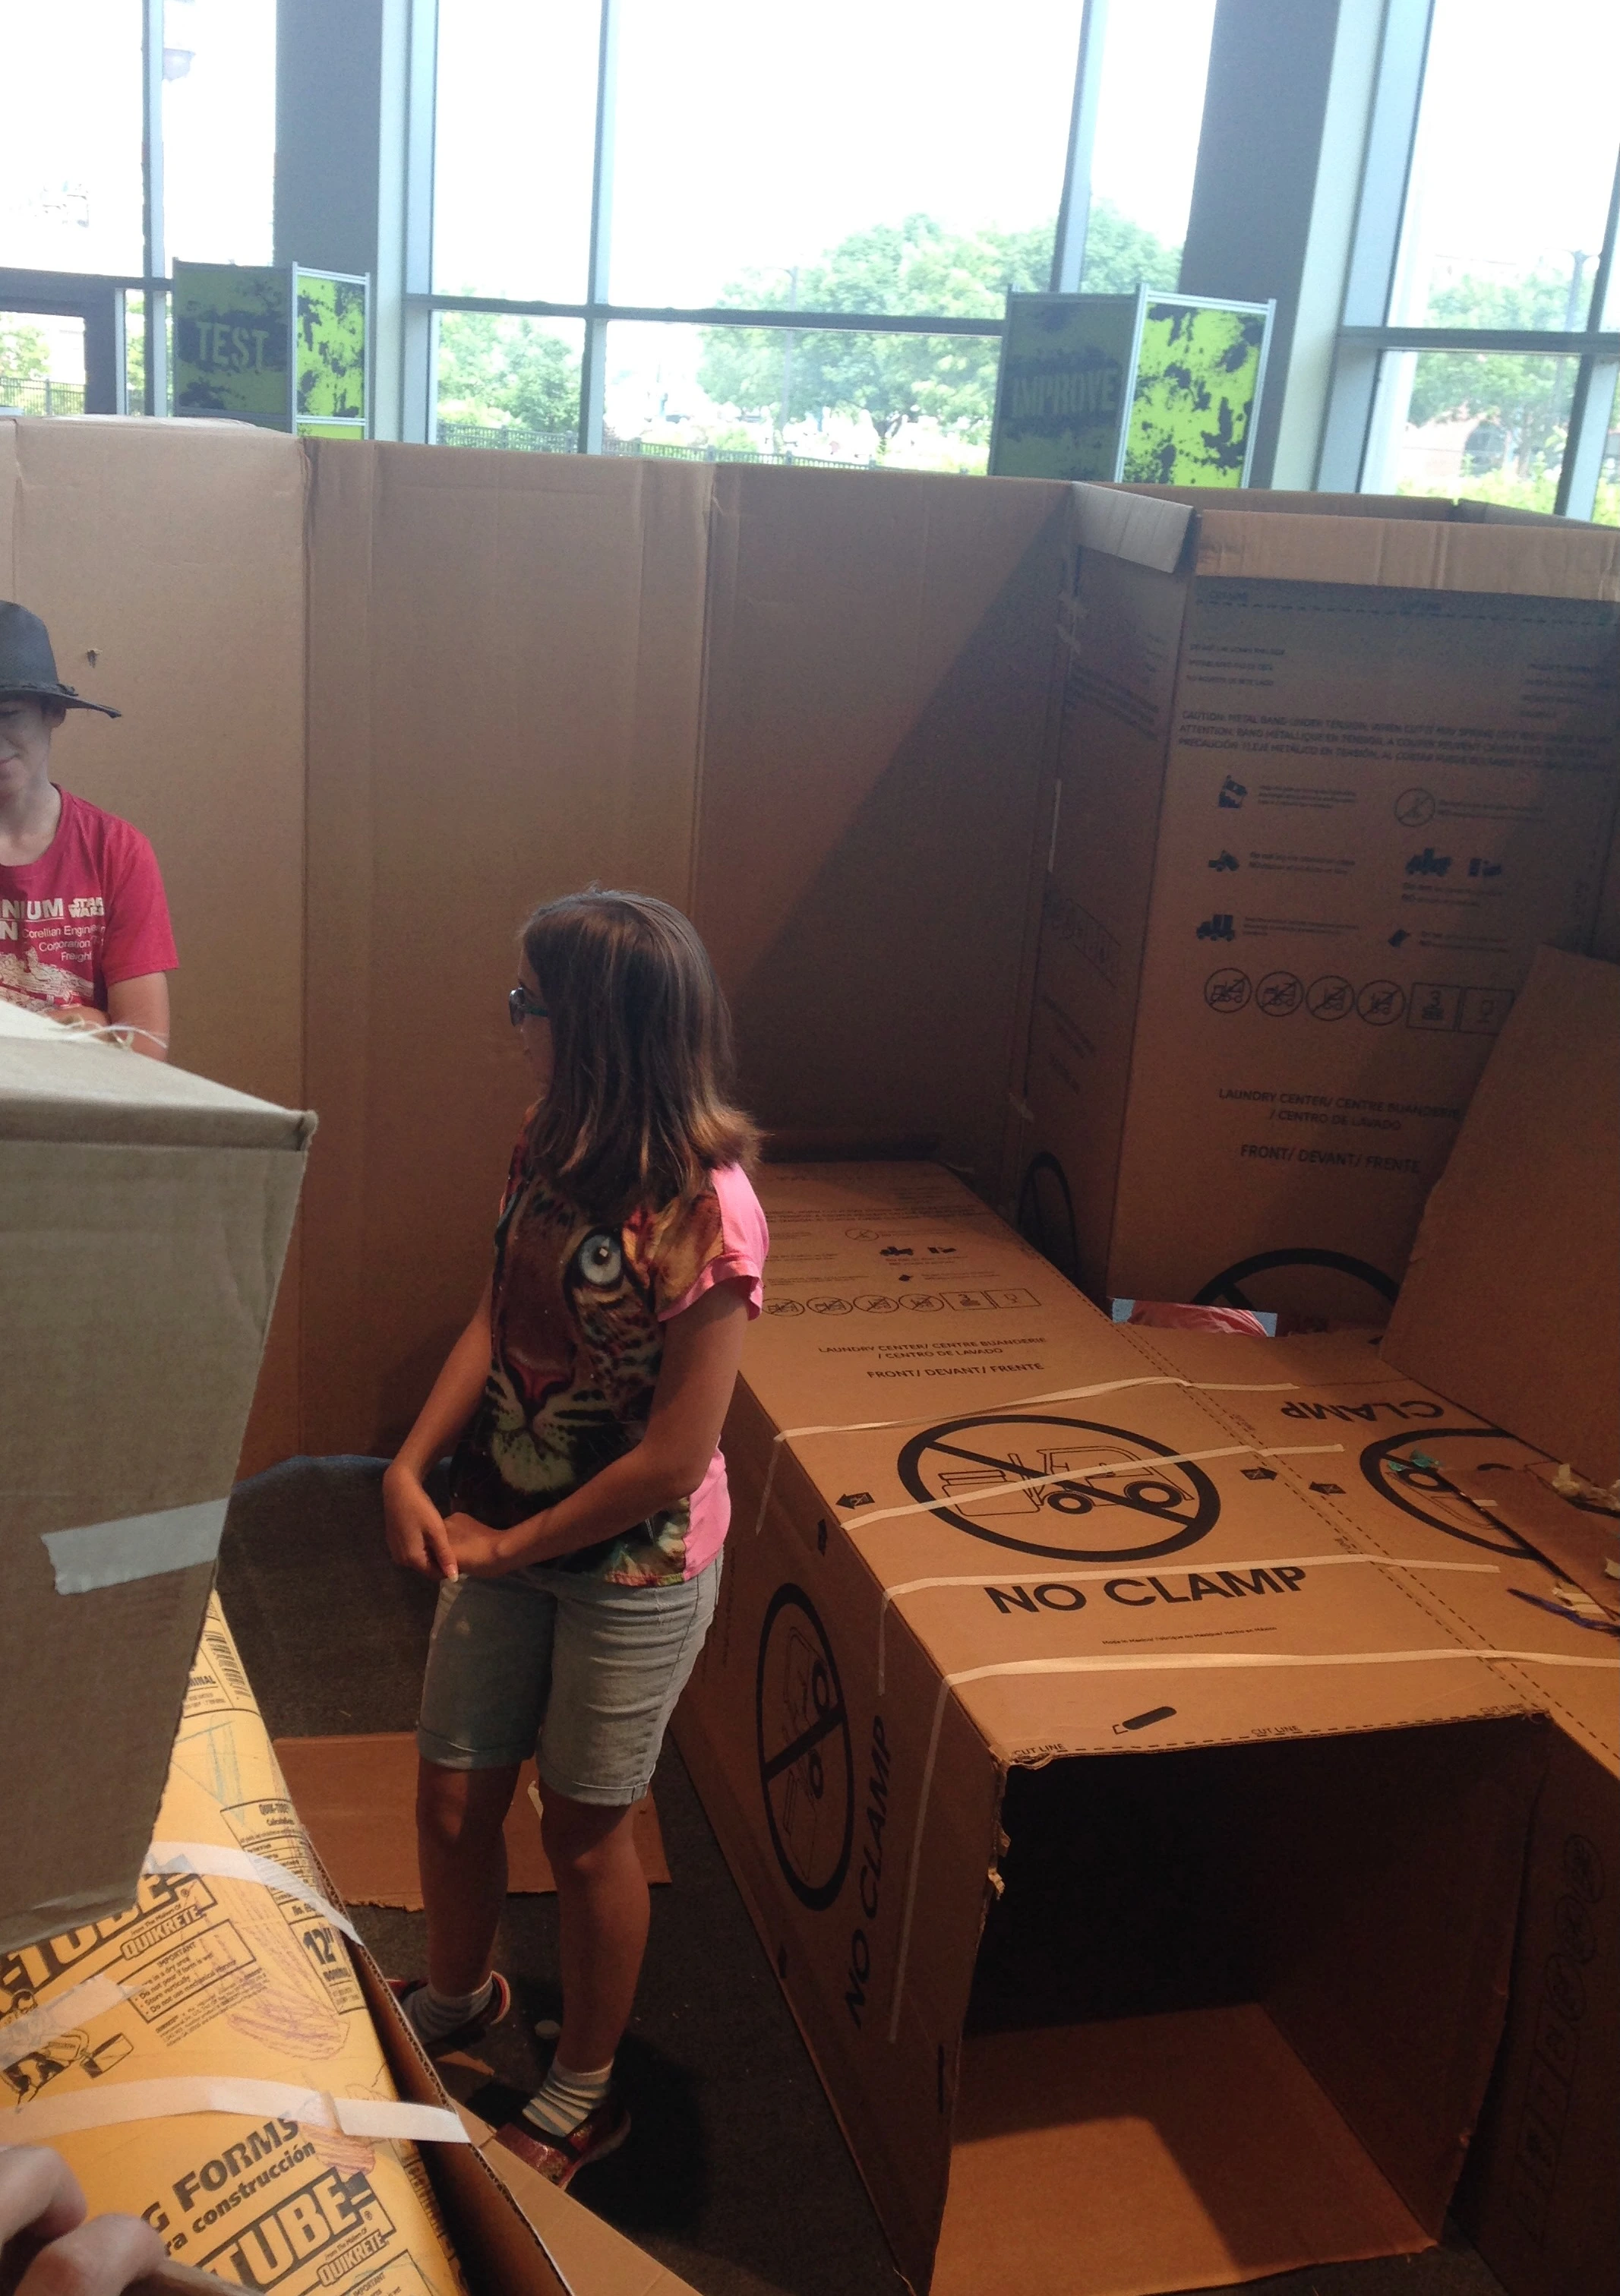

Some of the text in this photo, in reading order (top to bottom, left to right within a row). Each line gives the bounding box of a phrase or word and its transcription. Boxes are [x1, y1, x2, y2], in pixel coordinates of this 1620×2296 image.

[196, 321, 269, 370] TEST
[68, 905, 105, 917] WARS
[72, 897, 103, 907] STAR
[1217, 1088, 1276, 1102] LAUNDRY
[1335, 1097, 1386, 1111] CENTRE
[1278, 1110, 1328, 1123] CENTRO
[885, 1350, 934, 1360] CENTRO
[936, 1350, 955, 1358] DE
[955, 1347, 1003, 1356] LAVADO
[932, 1341, 975, 1350] CENTRE
[990, 1363, 1045, 1373] FRENTE
[1281, 1401, 1444, 1422] CLAMP
[984, 1566, 1306, 1614] NO CLAMP
[1251, 1724, 1302, 1735] CUT LINE
[1013, 1747, 1036, 1755] CUT
[861, 1716, 892, 1919] CLAMP
[120, 1905, 202, 1961] QUIKRETE
[156, 1941, 196, 1967] IMPORTANT
[844, 1928, 871, 2029] NO
[139, 1991, 150, 2000] Do
[151, 1982, 162, 1991] not
[144, 1992, 163, 2006] Store
[150, 2004, 162, 2014] Do
[161, 1998, 172, 2008] not
[172, 1991, 183, 2000] use
[172, 2111, 300, 2212] FORMS
[191, 2140, 317, 2234] construcción
[346, 2232, 362, 2245] Makers
[317, 2230, 388, 2288] QUIKRETE
